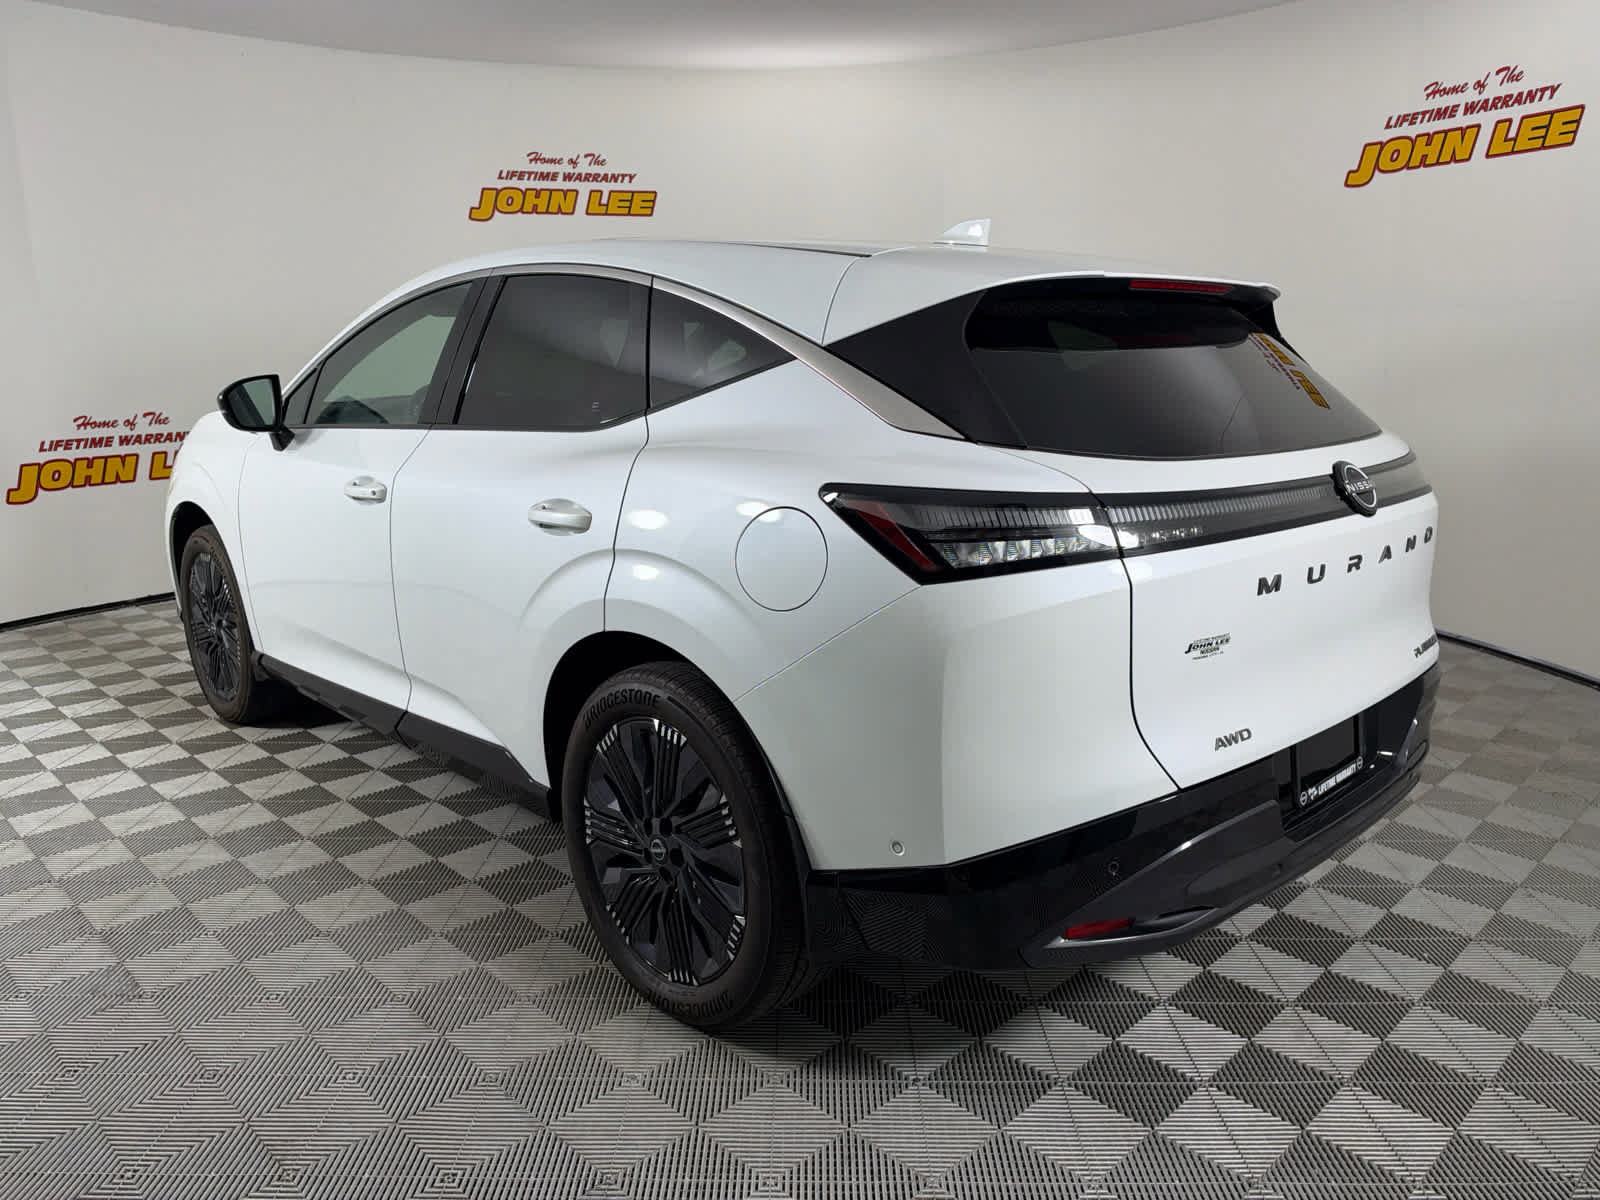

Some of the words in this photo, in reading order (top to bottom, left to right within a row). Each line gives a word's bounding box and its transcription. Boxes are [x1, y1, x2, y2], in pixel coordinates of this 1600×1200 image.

[1424, 81, 1469, 100] Home
[1473, 72, 1490, 95] of
[1495, 65, 1524, 87] The
[1384, 103, 1460, 130] LIFETIME
[1463, 83, 1562, 116] WARRANTY
[526, 151, 564, 166] Home
[567, 154, 580, 169] of
[584, 153, 607, 167] The
[1344, 123, 1482, 188] JOHN
[1485, 104, 1585, 159] LEE
[497, 170, 560, 181] LIFETIME
[562, 172, 637, 184] WARRANTY
[469, 187, 579, 222] JOHN
[586, 190, 657, 217] LEE
[73, 415, 119, 431] Home
[123, 414, 138, 431] of
[142, 411, 170, 427] The
[38, 436, 115, 453] LIFETIME
[118, 431, 191, 447] WARRAN
[6, 453, 139, 504] JOHN
[1257, 526, 1433, 596] MURANO
[582, 688, 661, 728] BRIDGESTONE
[1214, 728, 1252, 752] AWD
